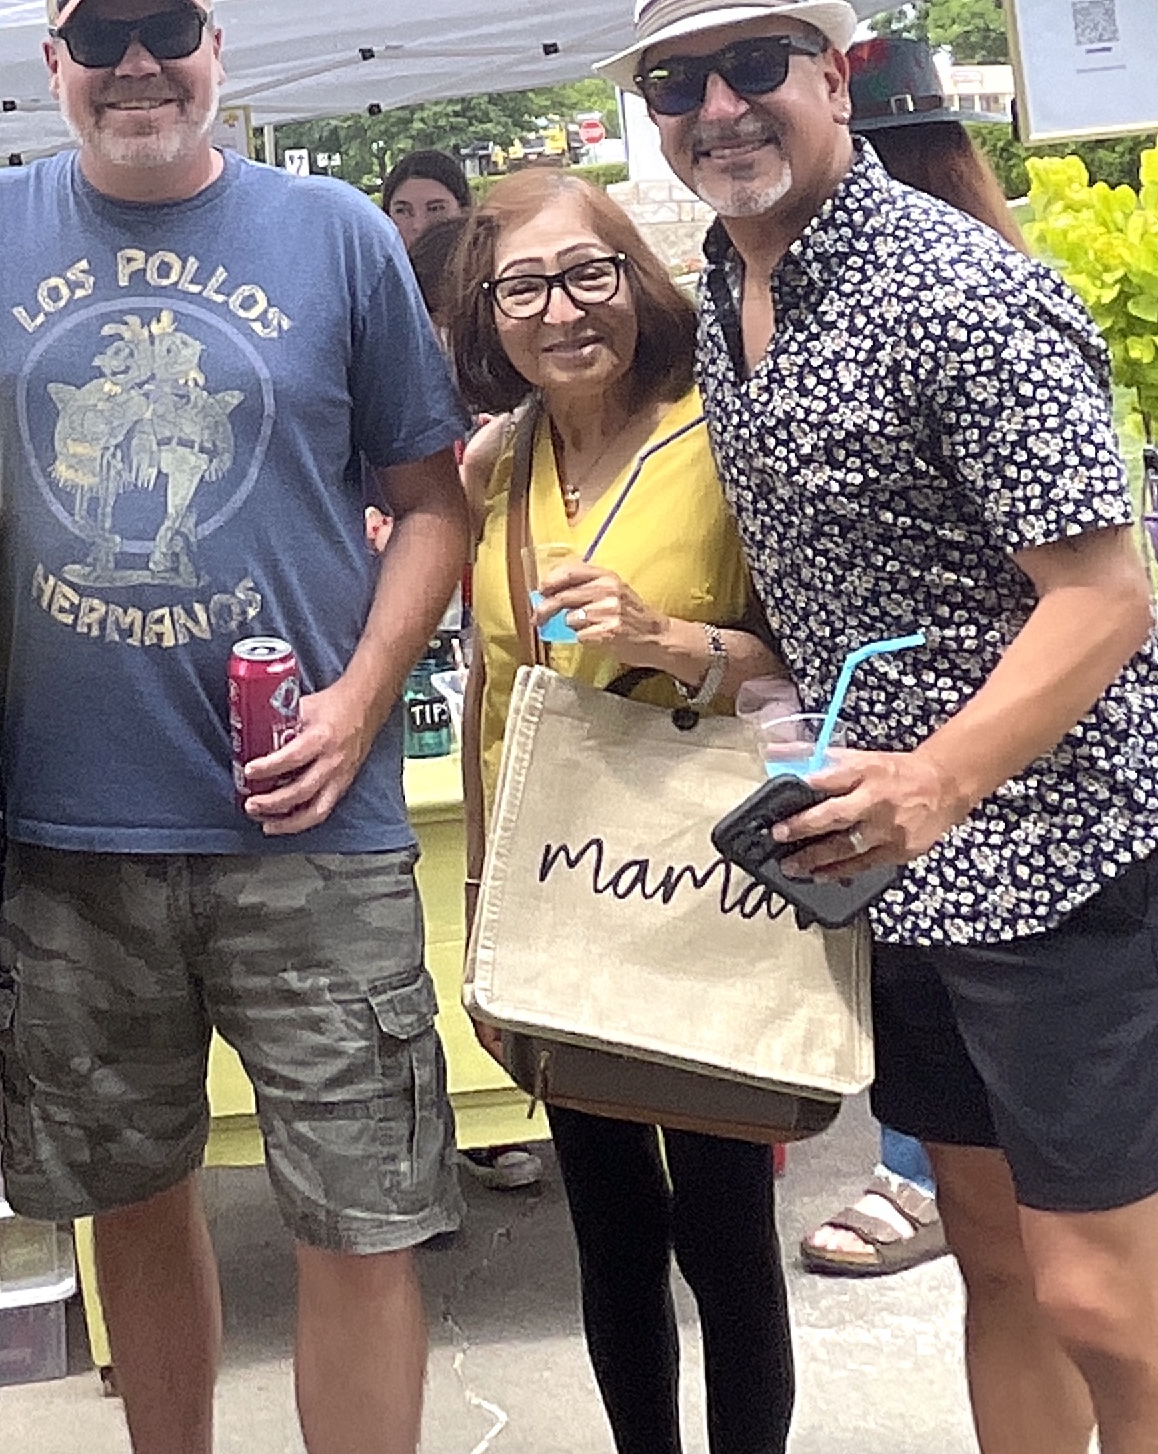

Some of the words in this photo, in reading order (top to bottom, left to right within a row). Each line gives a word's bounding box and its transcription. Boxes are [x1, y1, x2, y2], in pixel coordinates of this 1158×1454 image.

[12, 258, 95, 333] LOS
[116, 248, 292, 338] POLLOS
[32, 562, 262, 648] HERMANOS
